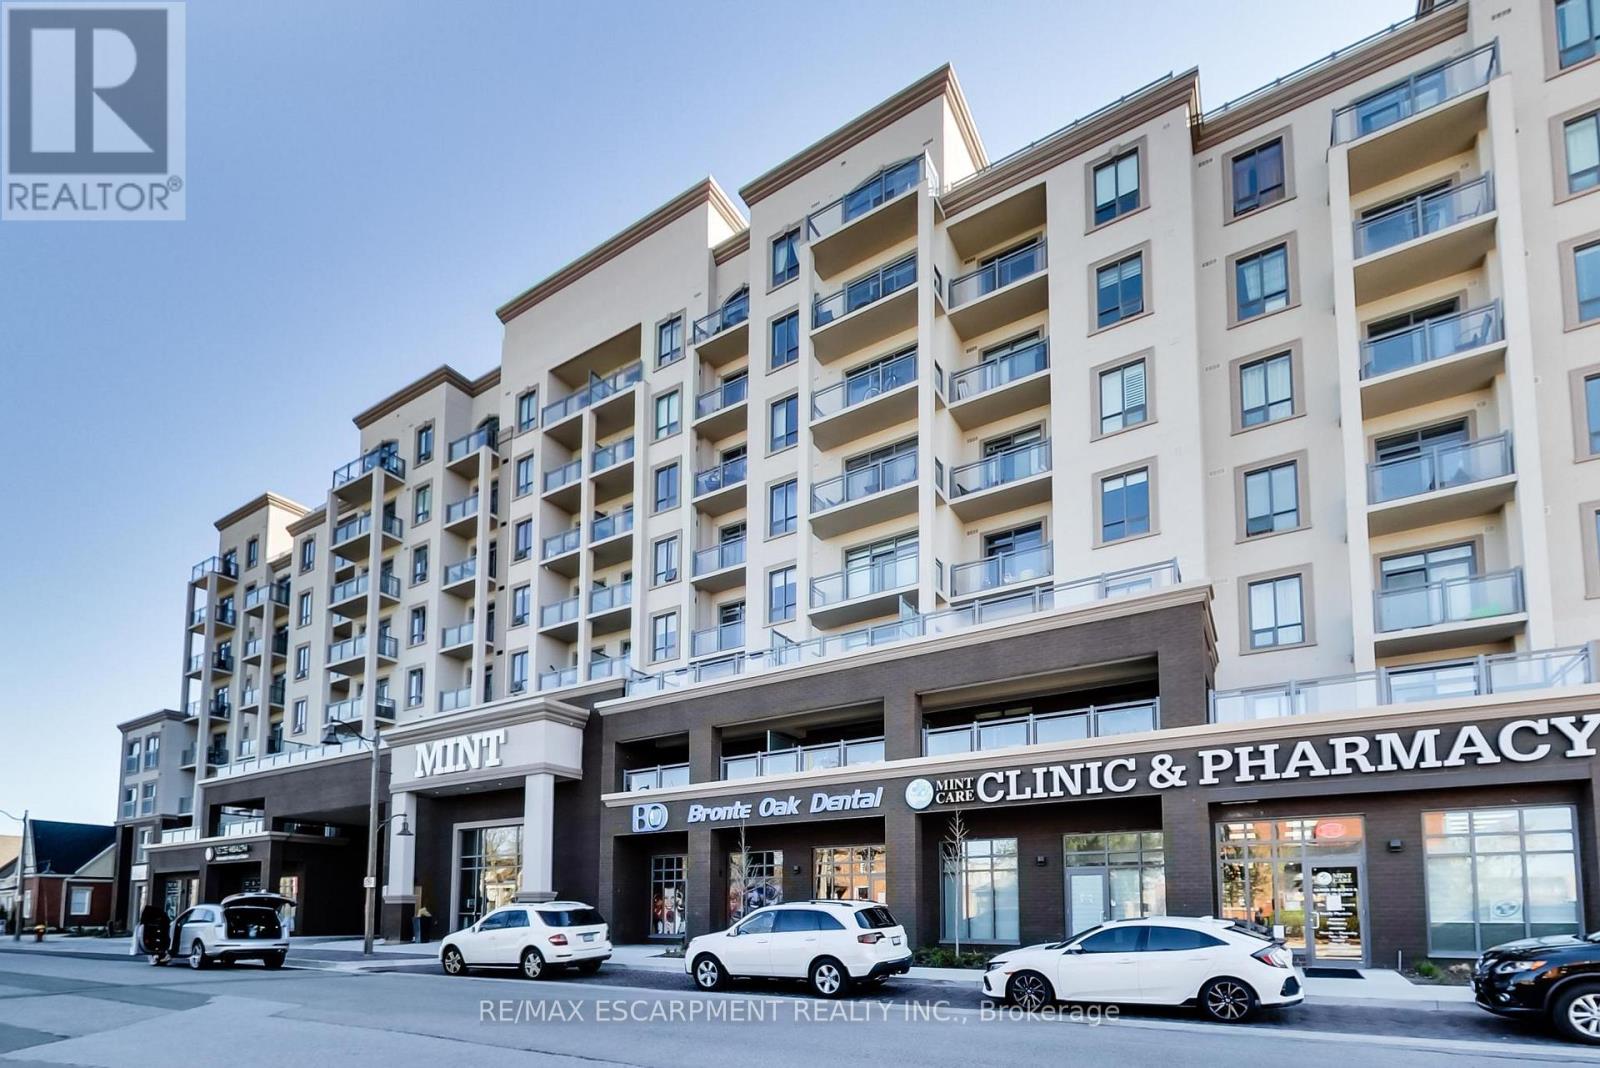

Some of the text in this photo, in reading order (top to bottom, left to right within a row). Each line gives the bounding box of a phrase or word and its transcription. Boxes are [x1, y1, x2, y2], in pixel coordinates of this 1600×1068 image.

[415, 729, 505, 778] MINT
[976, 714, 1600, 803] CLINIC & PHARMACY
[935, 789, 975, 804] CARE
[936, 777, 974, 791] MINT
[687, 787, 883, 823] Bronte Oak Dental
